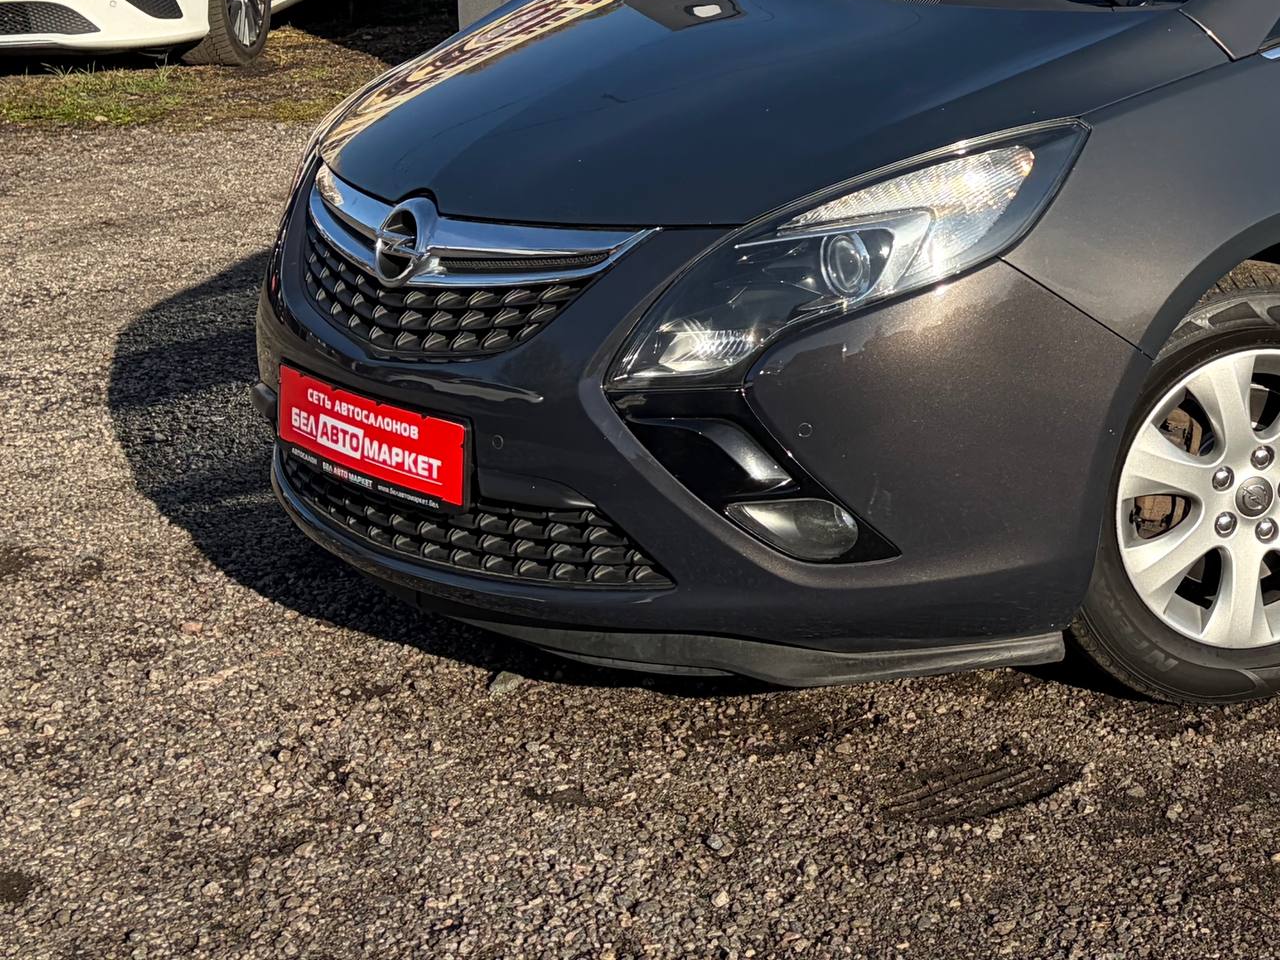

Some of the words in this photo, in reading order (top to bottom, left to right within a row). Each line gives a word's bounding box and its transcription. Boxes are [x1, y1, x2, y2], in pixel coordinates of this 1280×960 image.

[307, 388, 331, 409] СЕТЬ
[334, 399, 419, 440] АВТОСАЛОНОВ
[291, 407, 317, 437] БЕЛ
[320, 419, 360, 453] АВТО
[363, 437, 442, 480] МАРКЕТ
[322, 461, 333, 473] БЕЛ
[333, 466, 348, 479] АВТО
[348, 472, 373, 487] МАРКЕТ
